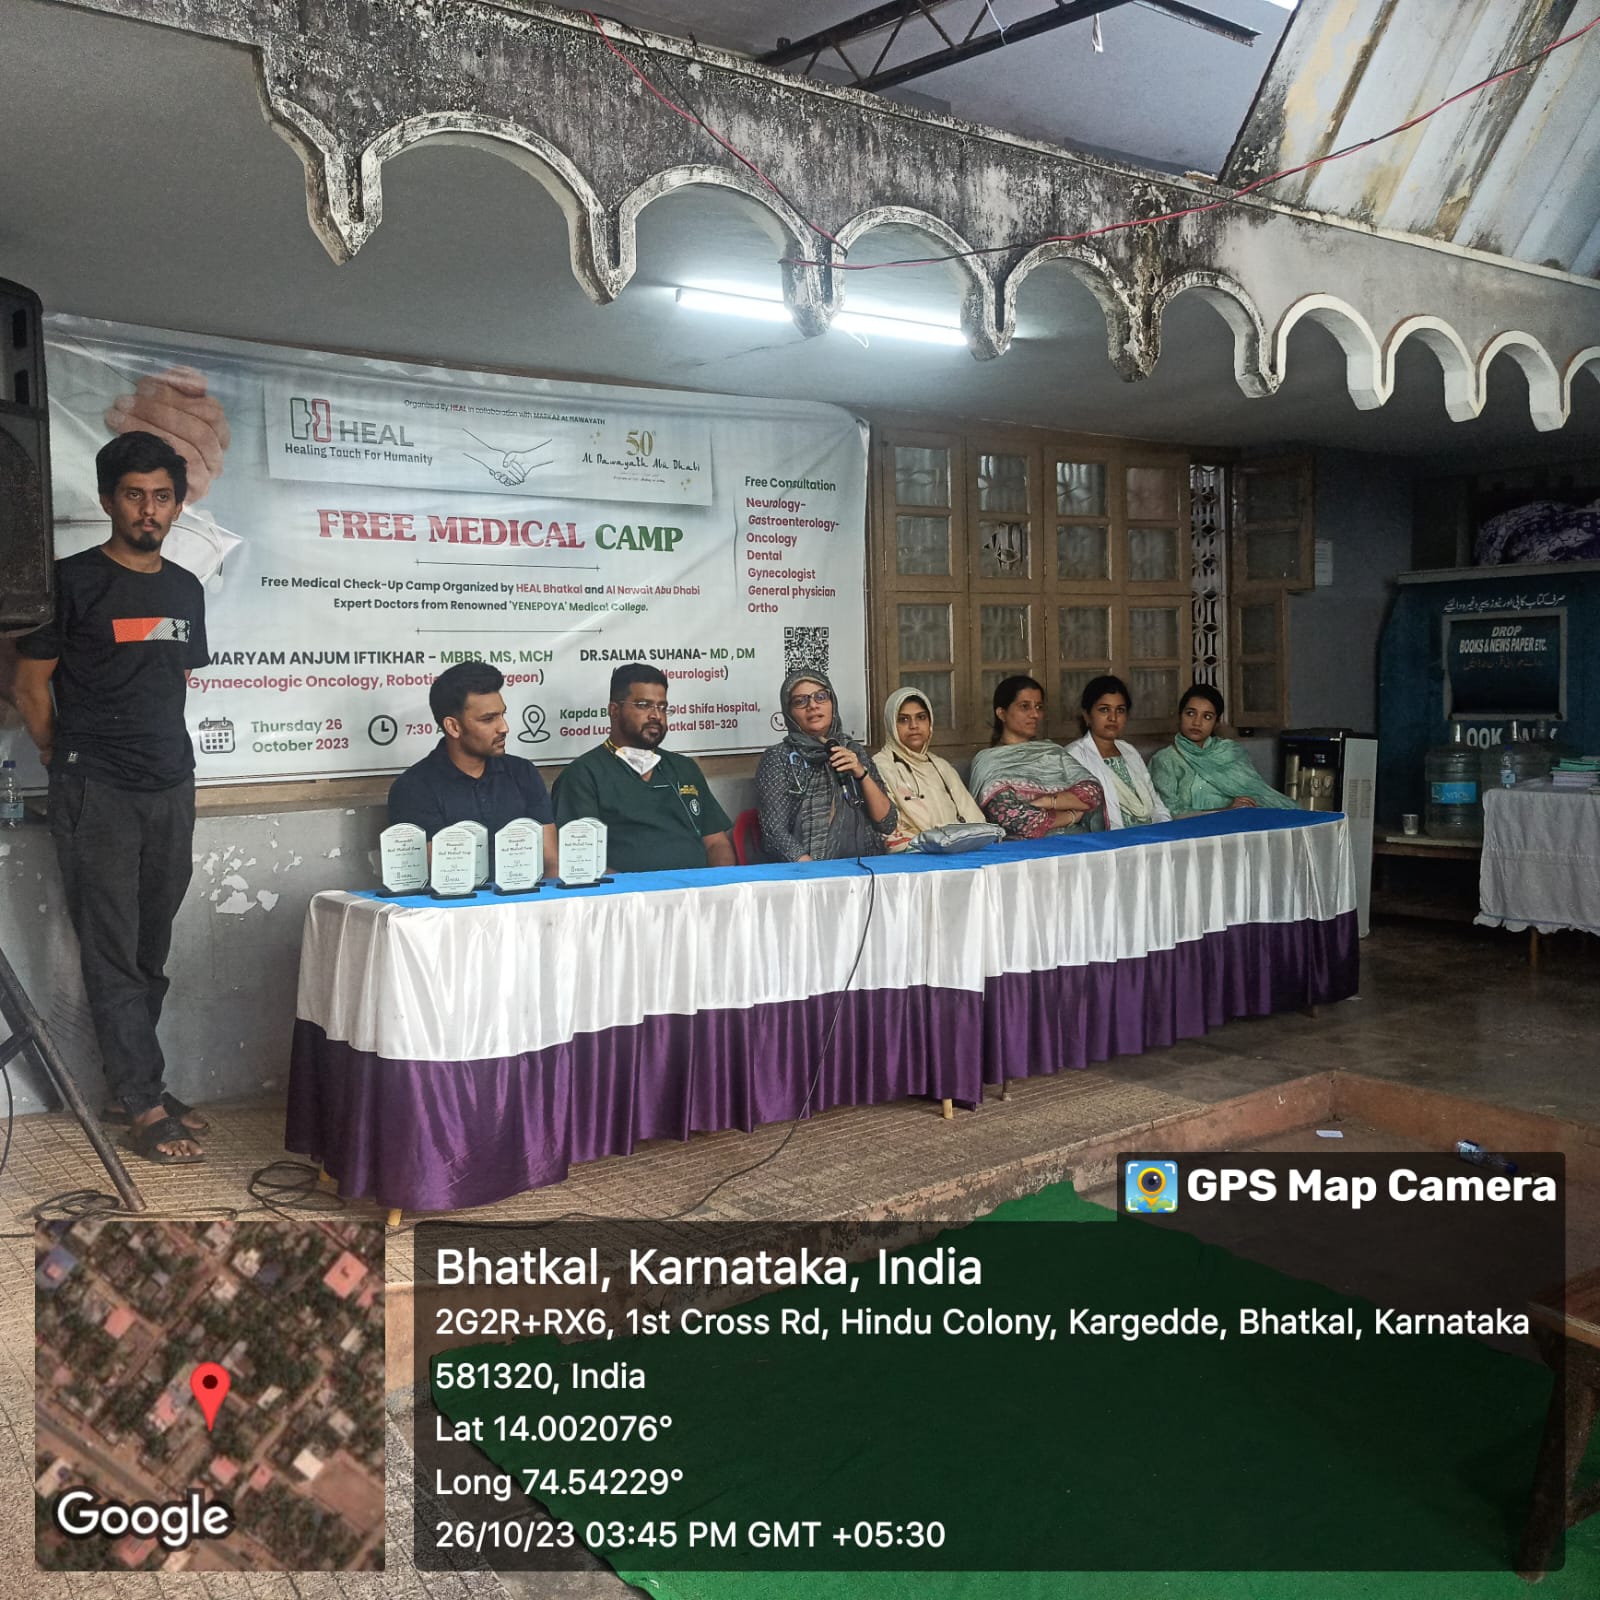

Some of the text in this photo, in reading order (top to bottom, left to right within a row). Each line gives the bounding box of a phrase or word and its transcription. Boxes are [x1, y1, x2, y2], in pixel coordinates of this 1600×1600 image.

[340, 420, 414, 447] HEAL
[285, 442, 433, 466] Healing Touch For Humanity
[744, 476, 836, 491] Free Consultation
[317, 509, 684, 552] FREE MEDICAL CAMP
[746, 532, 797, 547] Oncology
[746, 550, 782, 561] Dental
[748, 568, 816, 582] Gynecologist
[261, 576, 289, 587] Free
[291, 577, 341, 589] Medical
[343, 579, 403, 592] Check-Up
[405, 580, 441, 593] Camp
[442, 581, 498, 594] Organized
[500, 583, 514, 595] by
[516, 583, 541, 593] HEAL
[543, 583, 583, 594] Bhatkal
[584, 584, 604, 594] and
[605, 585, 616, 594] Al
[655, 586, 671, 595] Abu
[673, 586, 700, 595] Dhabi
[748, 586, 836, 600] General physician
[333, 598, 372, 611] Expert
[374, 599, 419, 610] Doctors
[421, 599, 448, 610] from
[450, 600, 507, 610] Renowned
[569, 602, 609, 612] Medical
[612, 603, 649, 614] College.
[748, 602, 779, 614] Ortho
[1492, 625, 1522, 637] DROP
[1459, 639, 1484, 654] BOOKS
[209, 651, 285, 665] MARYAM
[290, 651, 350, 665] ANJUM
[354, 651, 425, 664] IFTIKHAR
[441, 651, 487, 664] MBBS,
[490, 651, 516, 664] MS,
[519, 650, 553, 663] MCH
[580, 649, 647, 661] DR.SALMA
[710, 648, 728, 659] MD
[737, 648, 755, 659] DM
[188, 674, 302, 693] Gynaecologic
[306, 674, 383, 691] Oncology,
[560, 707, 598, 722] Kapda
[688, 703, 714, 714] Shifa
[716, 701, 760, 715] Hospital,
[251, 719, 343, 734] Thursday 26
[406, 723, 433, 735] 7:30
[560, 725, 590, 736] Good
[698, 719, 738, 730] 581-320
[252, 738, 349, 753] October 2023
